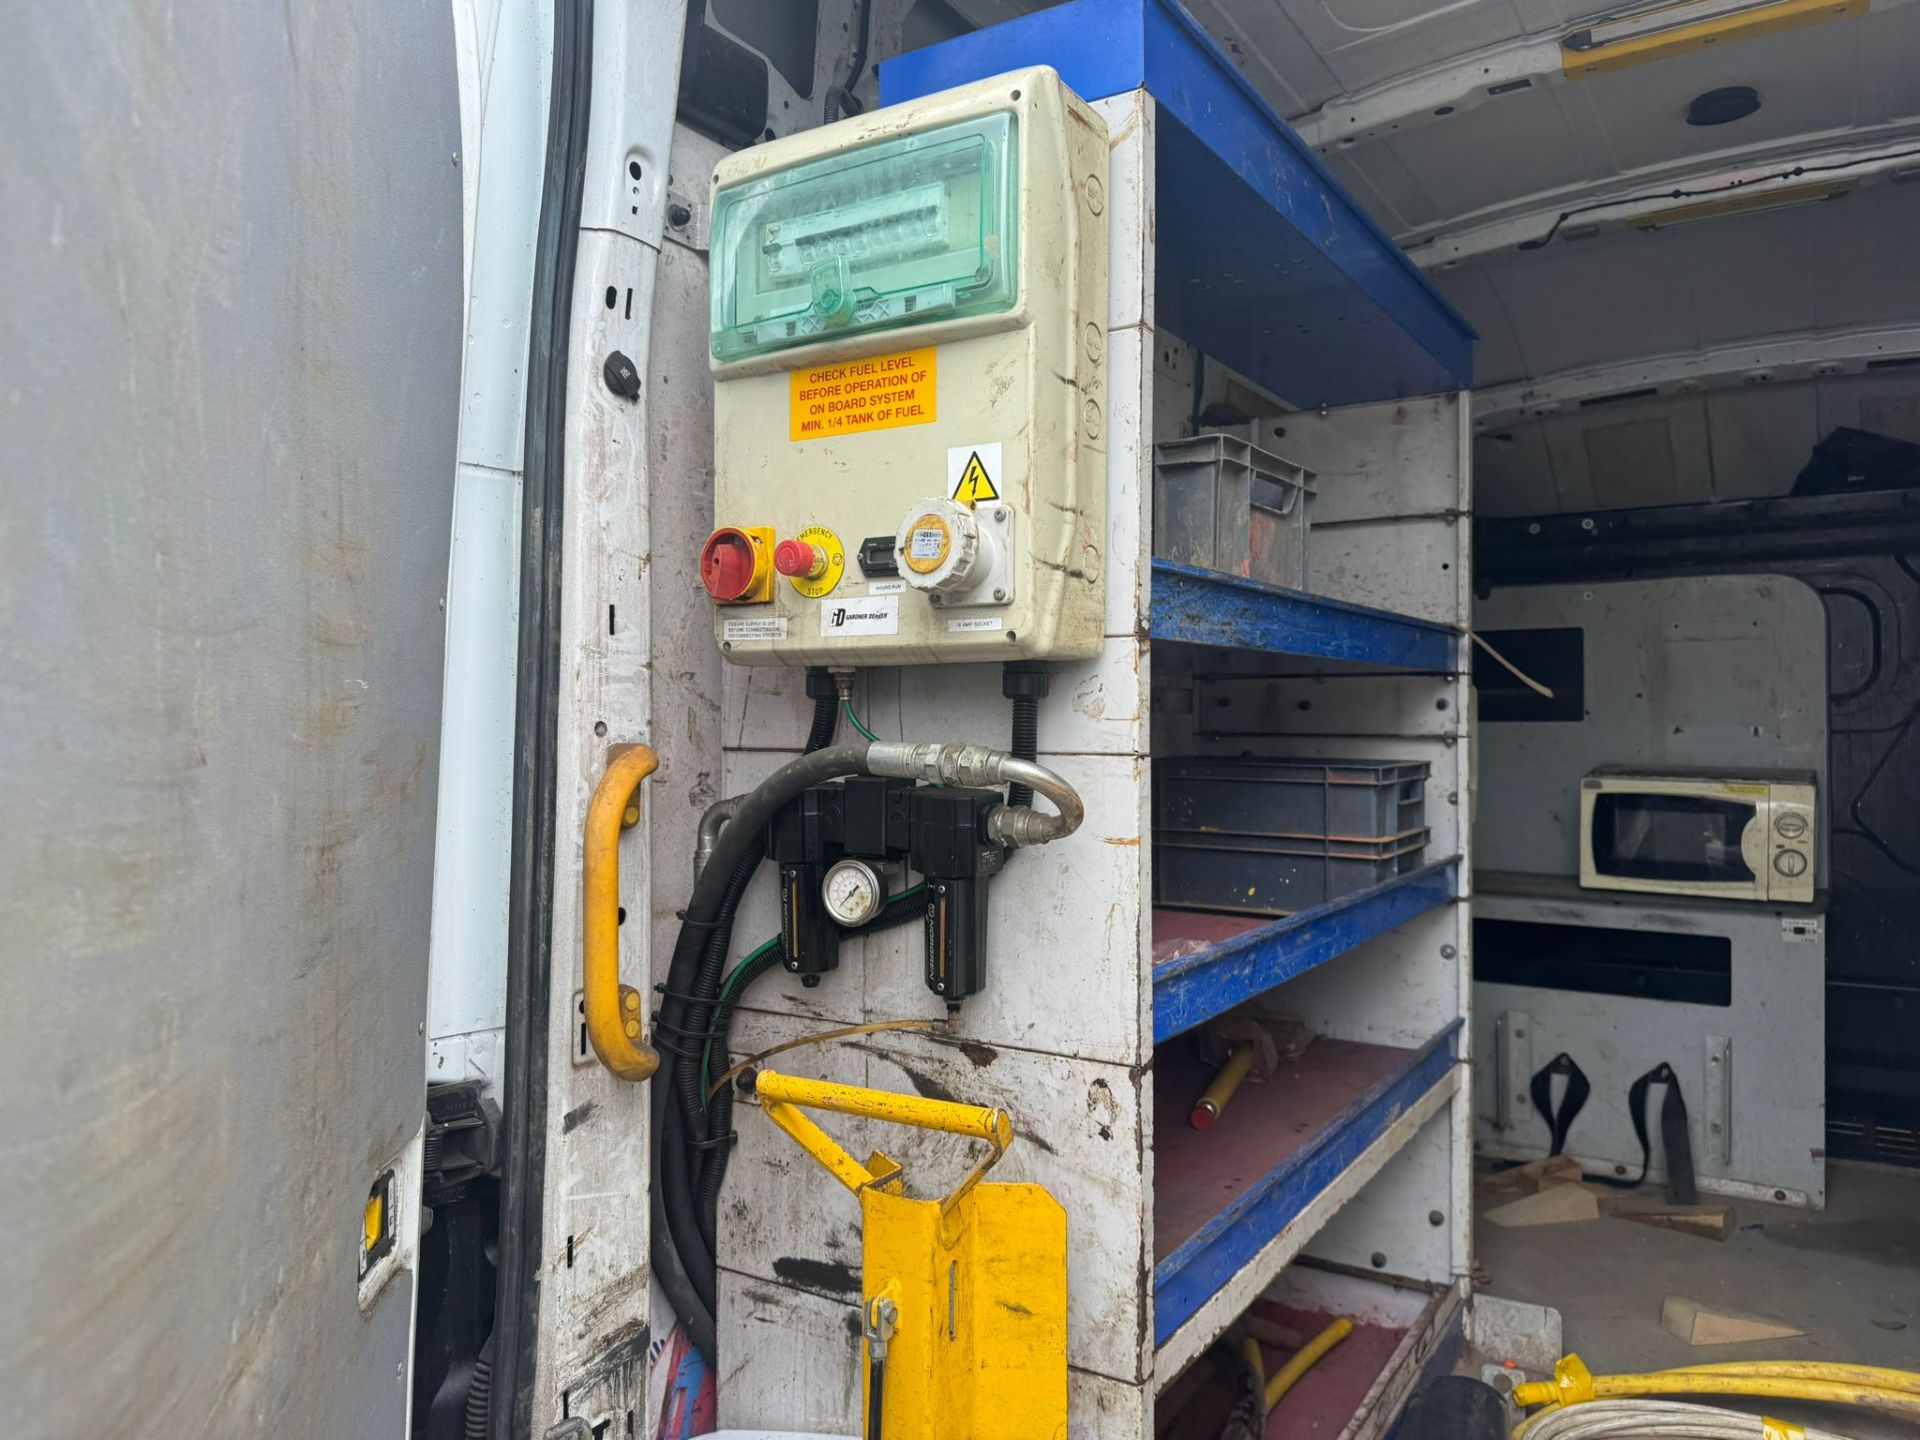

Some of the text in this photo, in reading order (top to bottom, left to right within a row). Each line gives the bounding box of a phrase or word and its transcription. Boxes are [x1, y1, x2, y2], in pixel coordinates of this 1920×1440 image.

[810, 356, 915, 384] CHECK FUEL LEVEL
[800, 370, 927, 401] BEFORE OPERATION OF
[810, 388, 915, 415] ON BOARD SYSTEM
[801, 404, 924, 433] MIN. 1/4 TANK OF FUEL
[796, 527, 833, 542] EMERGENCY
[806, 587, 823, 596] STOP
